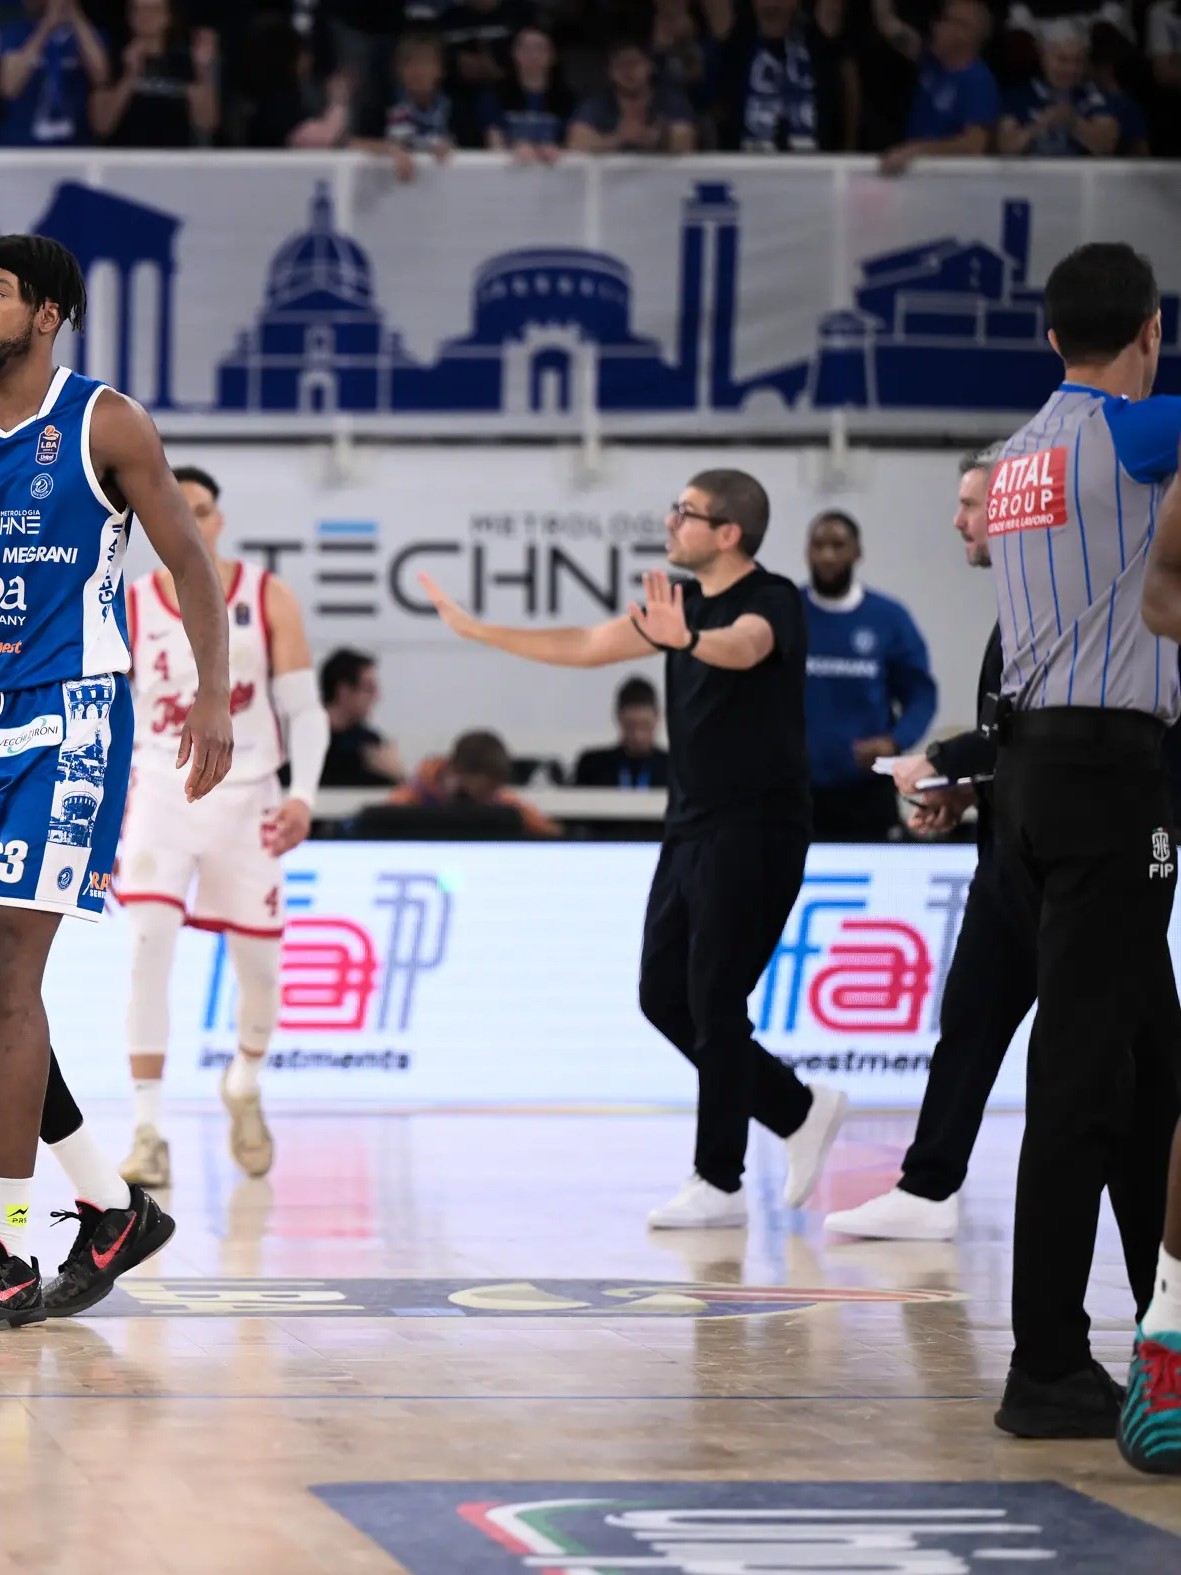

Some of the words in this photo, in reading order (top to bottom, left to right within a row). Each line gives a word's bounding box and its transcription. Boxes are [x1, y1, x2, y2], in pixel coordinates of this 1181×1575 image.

[40, 441, 57, 449] LBA
[992, 451, 1054, 496] ATTAL
[988, 488, 1053, 520] GROUP
[2, 545, 79, 564] MEGRANI
[154, 651, 169, 682] 4
[27, 726, 59, 739] ZIRONI
[1149, 863, 1174, 879] FIP
[265, 886, 278, 917] 4
